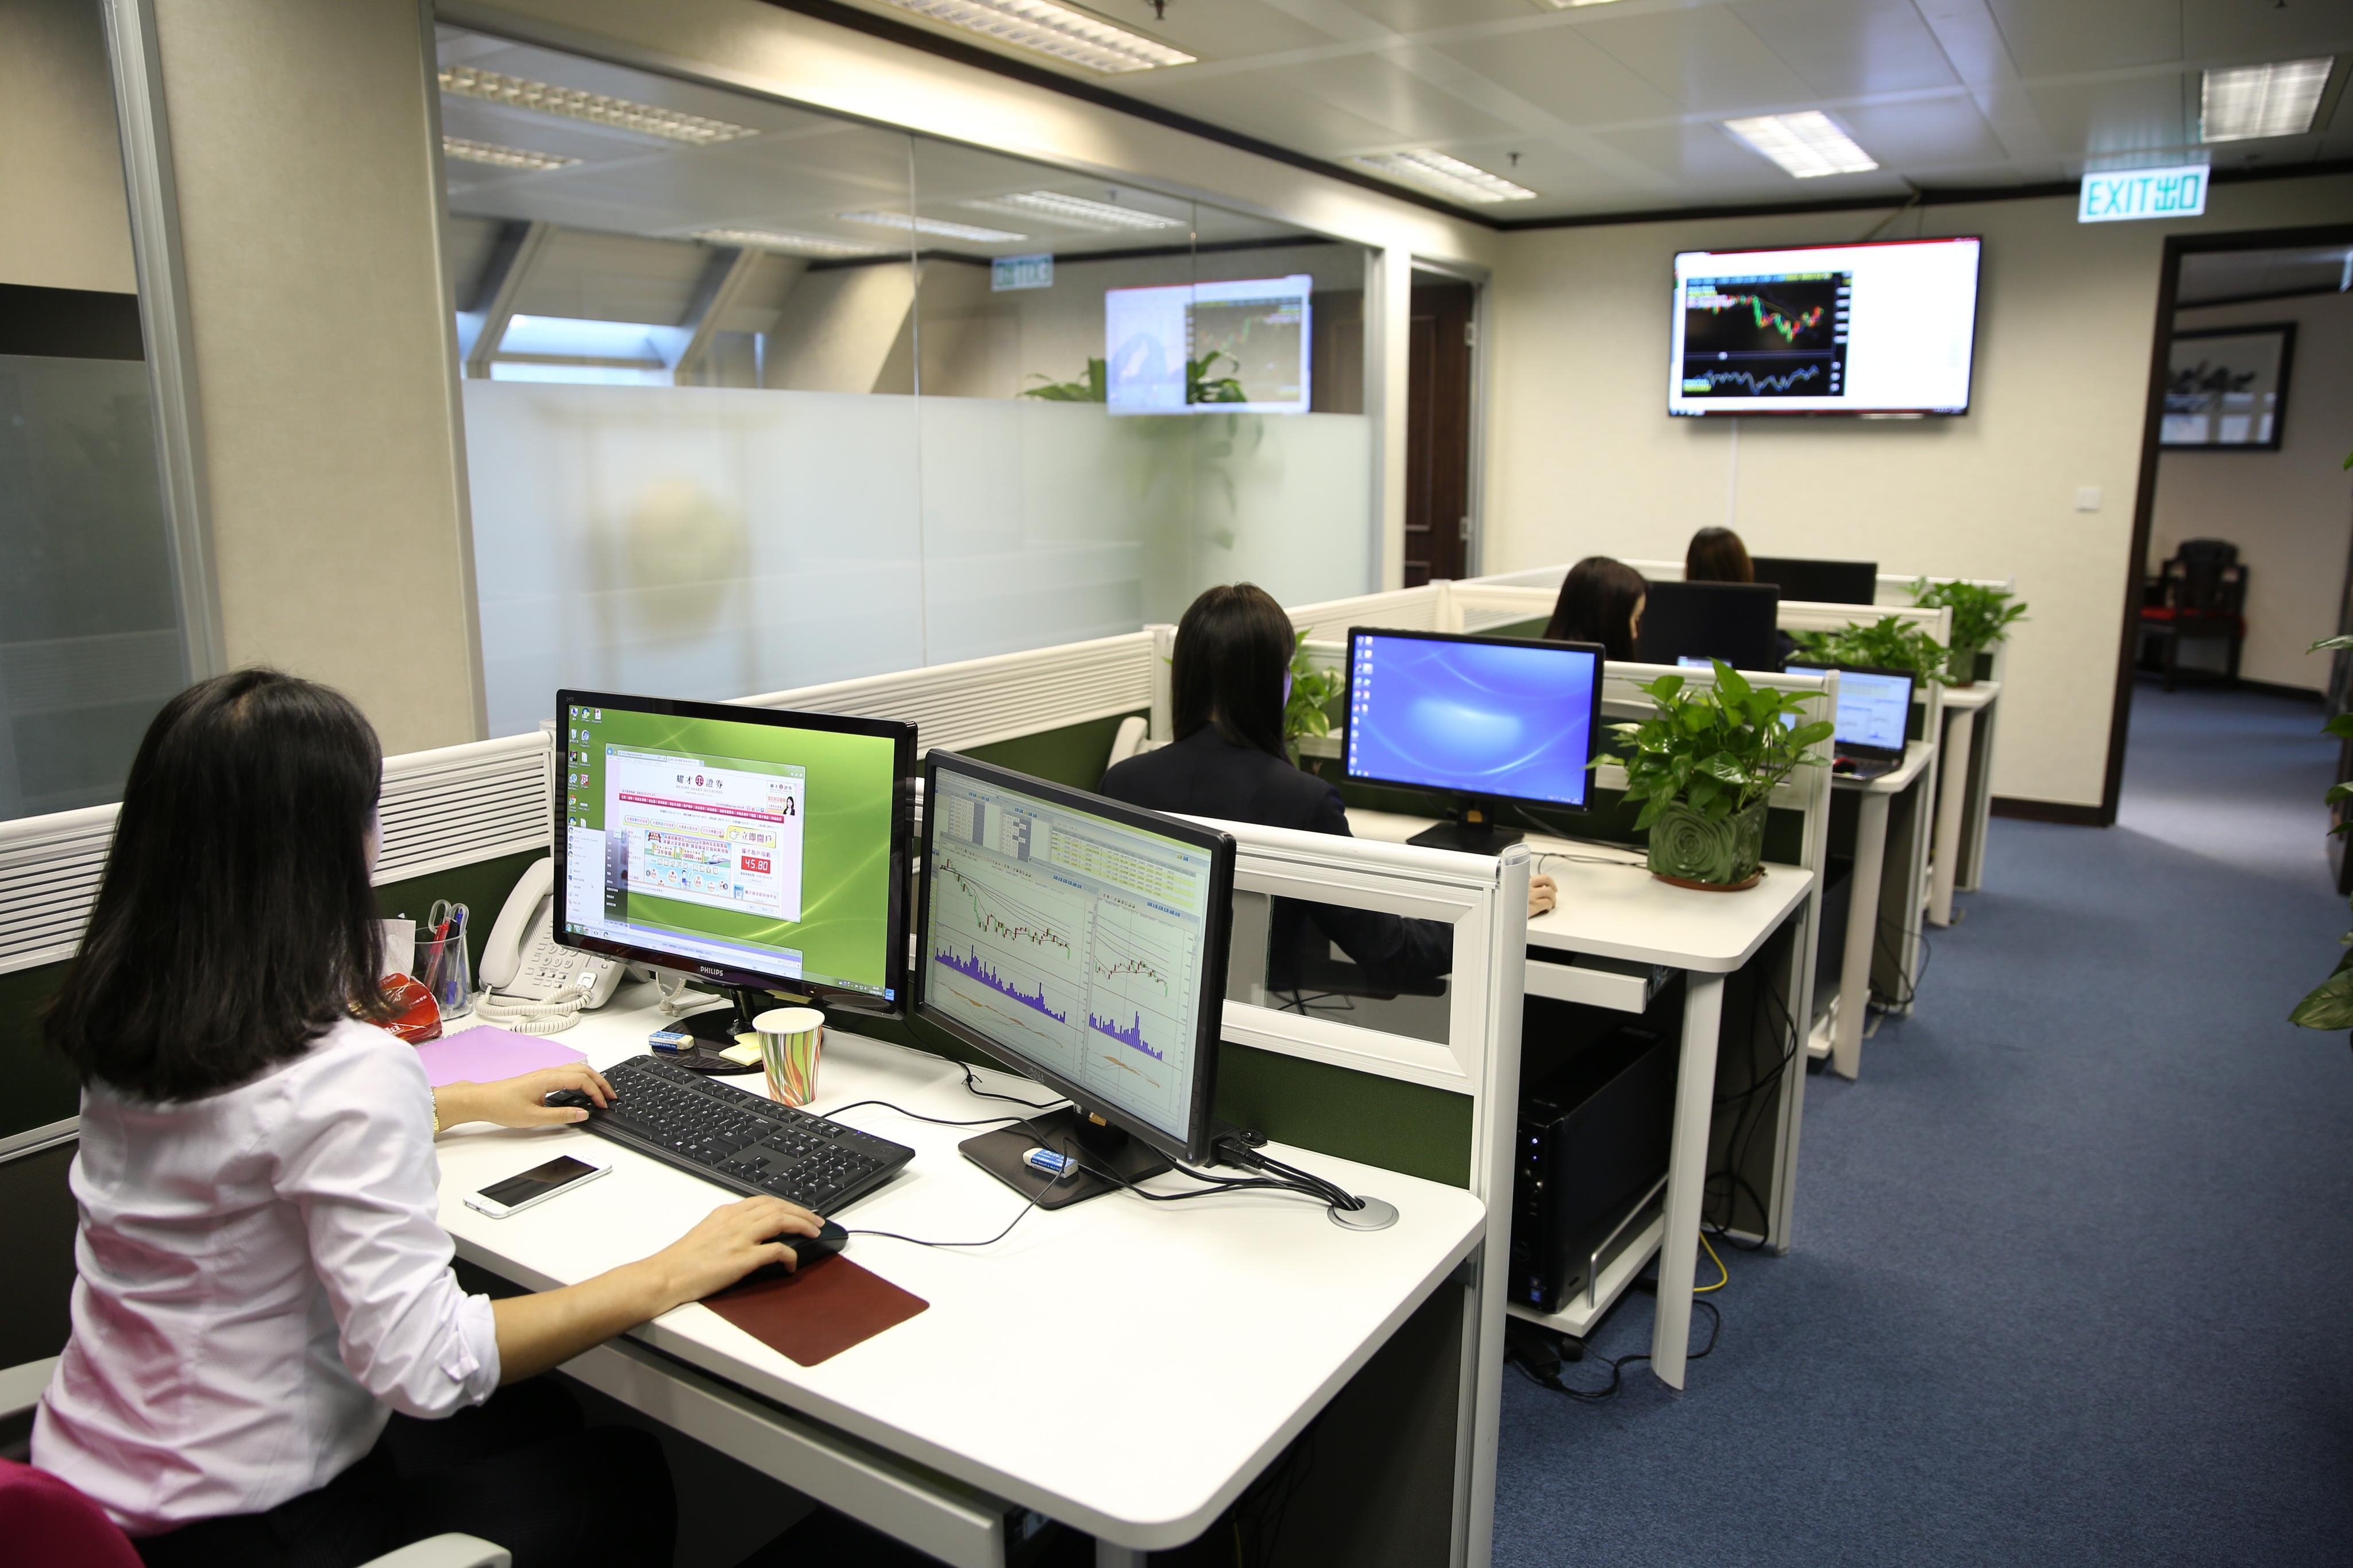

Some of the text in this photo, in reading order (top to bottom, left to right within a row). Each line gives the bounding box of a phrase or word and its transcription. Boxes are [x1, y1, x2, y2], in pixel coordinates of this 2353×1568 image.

[2087, 174, 2201, 215] EXIT 出口
[676, 774, 723, 789] 耀才 證券
[742, 831, 772, 844] 立即開戶
[745, 859, 768, 871] 45.80
[700, 966, 723, 976] PHILIPS
